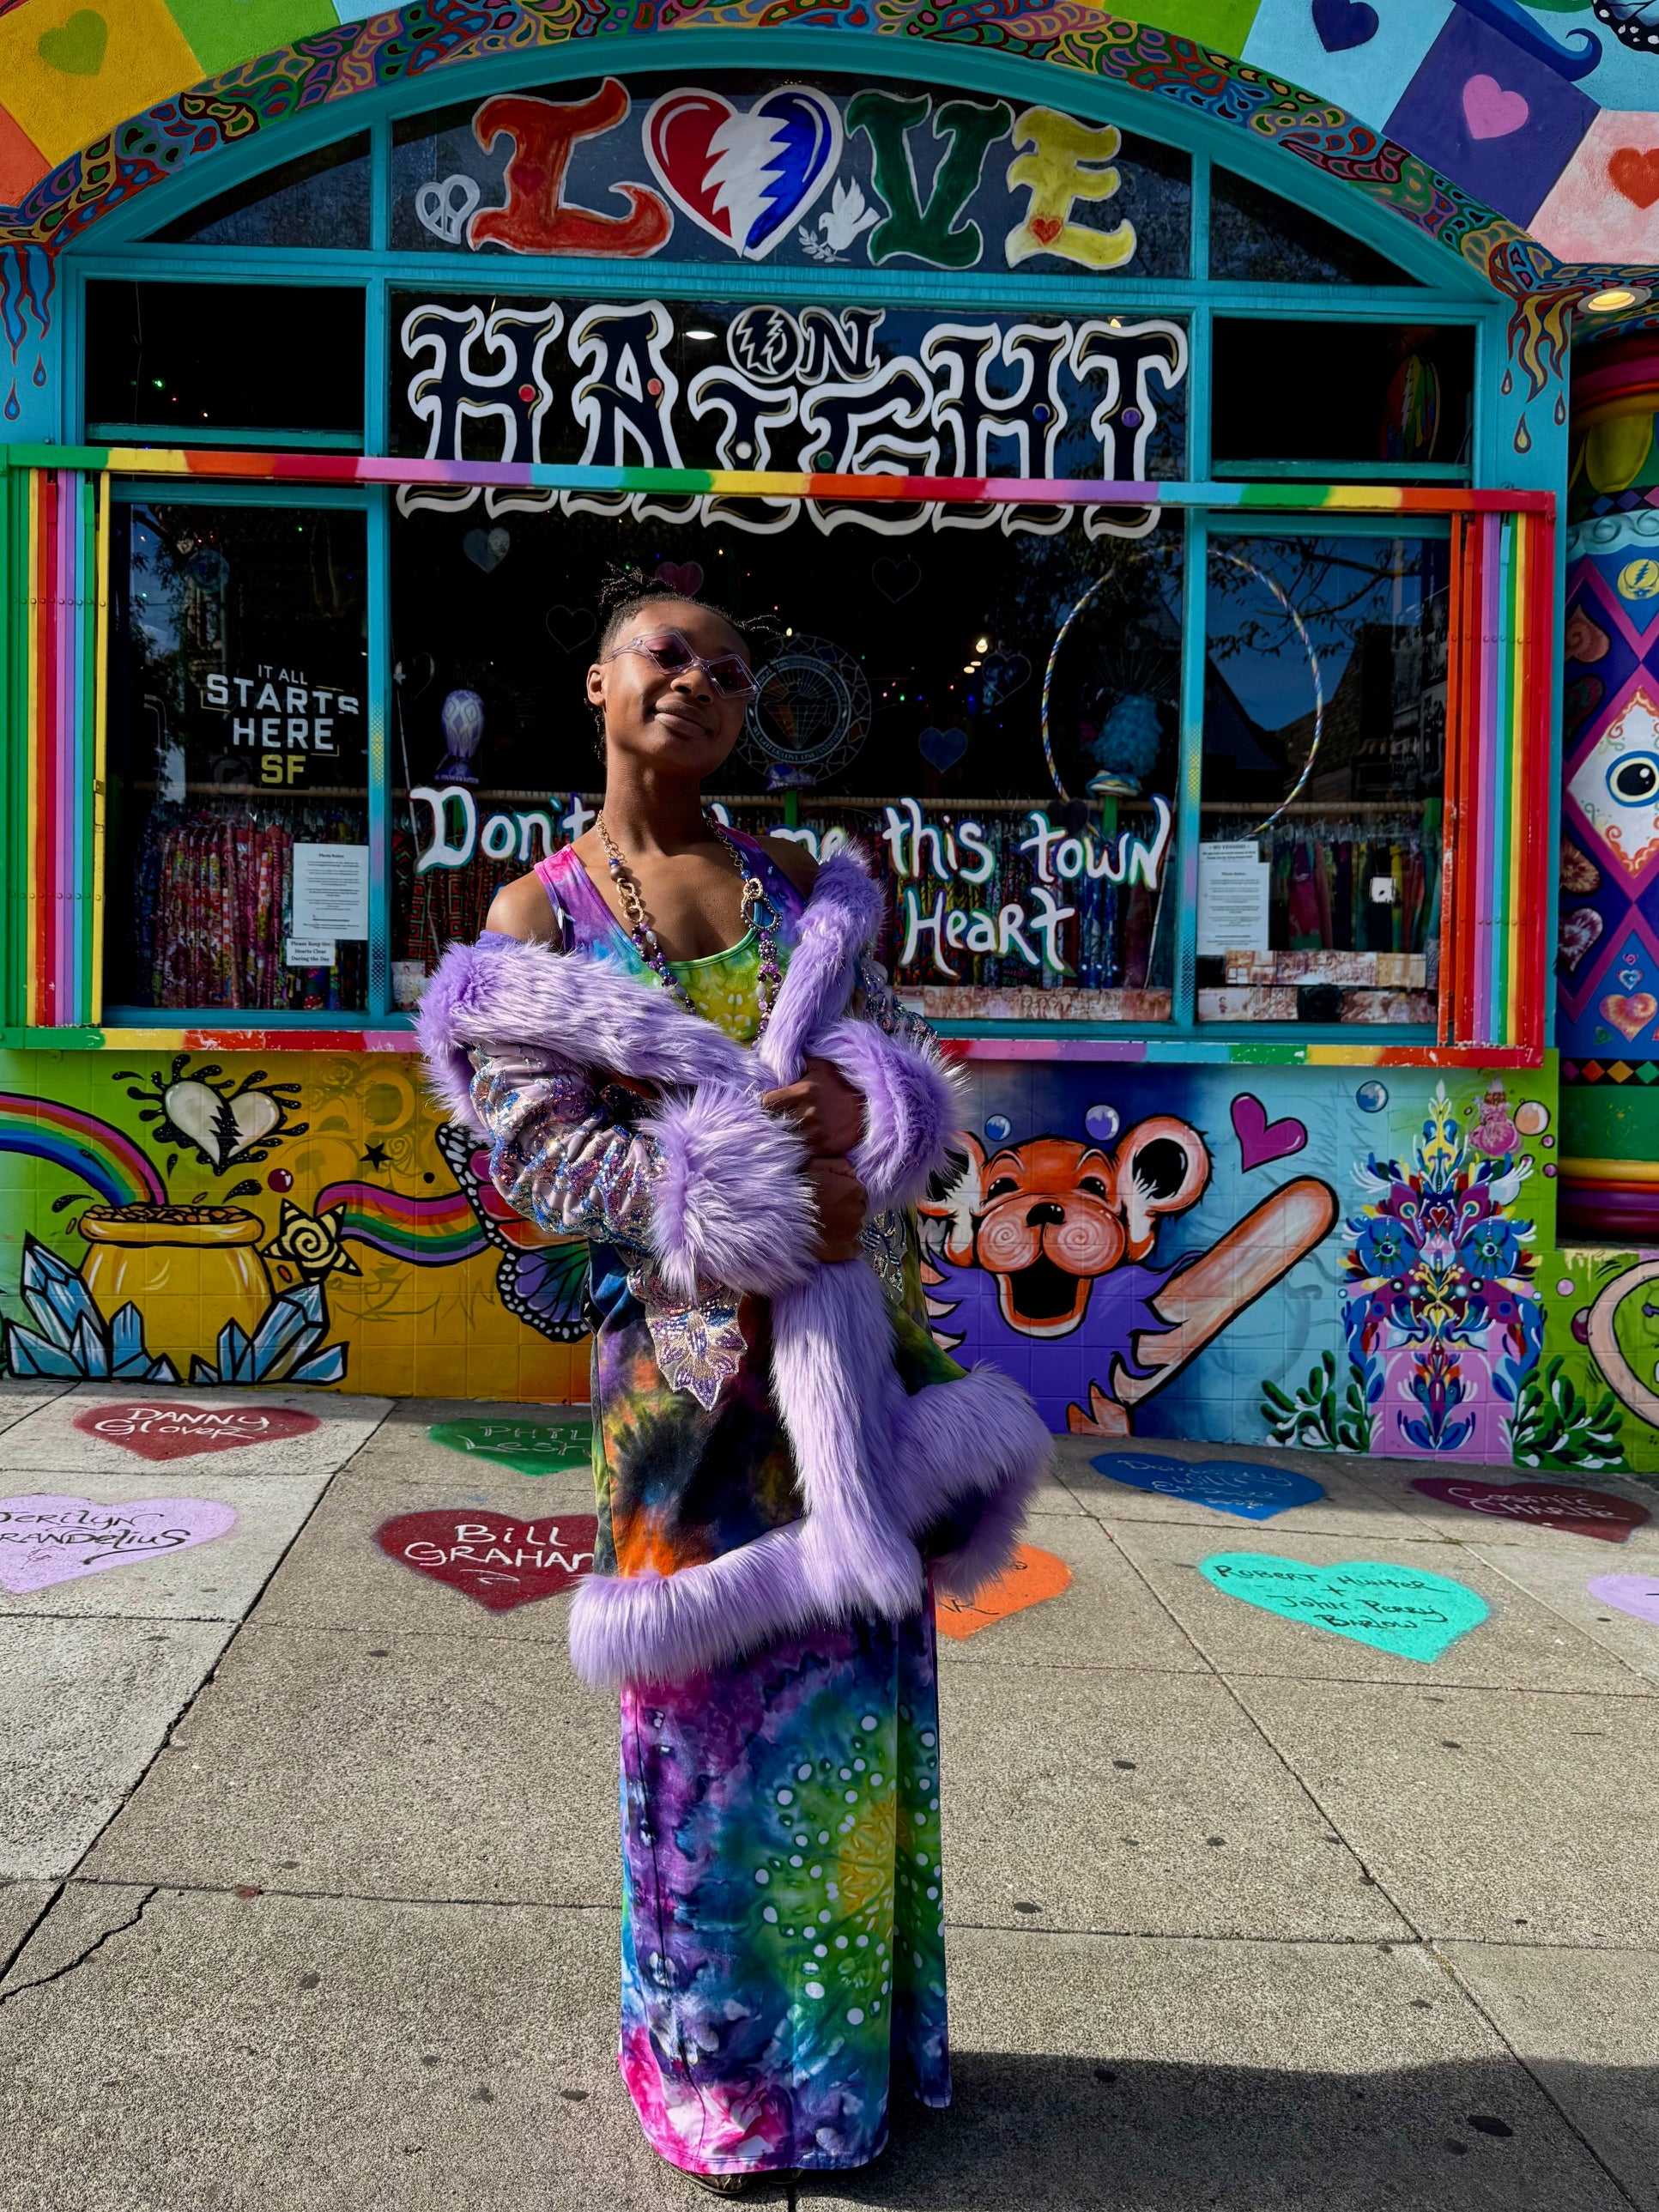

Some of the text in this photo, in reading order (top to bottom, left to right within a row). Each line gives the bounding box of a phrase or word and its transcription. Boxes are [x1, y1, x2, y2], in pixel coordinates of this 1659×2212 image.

[727, 304, 885, 385] ON
[397, 300, 1189, 541] HAIGHT
[207, 673, 360, 715] STARTS
[258, 664, 308, 686] IT ALL
[233, 718, 334, 750] HERE
[261, 755, 306, 785] SF
[409, 785, 596, 876] Don't
[881, 795, 996, 885] this
